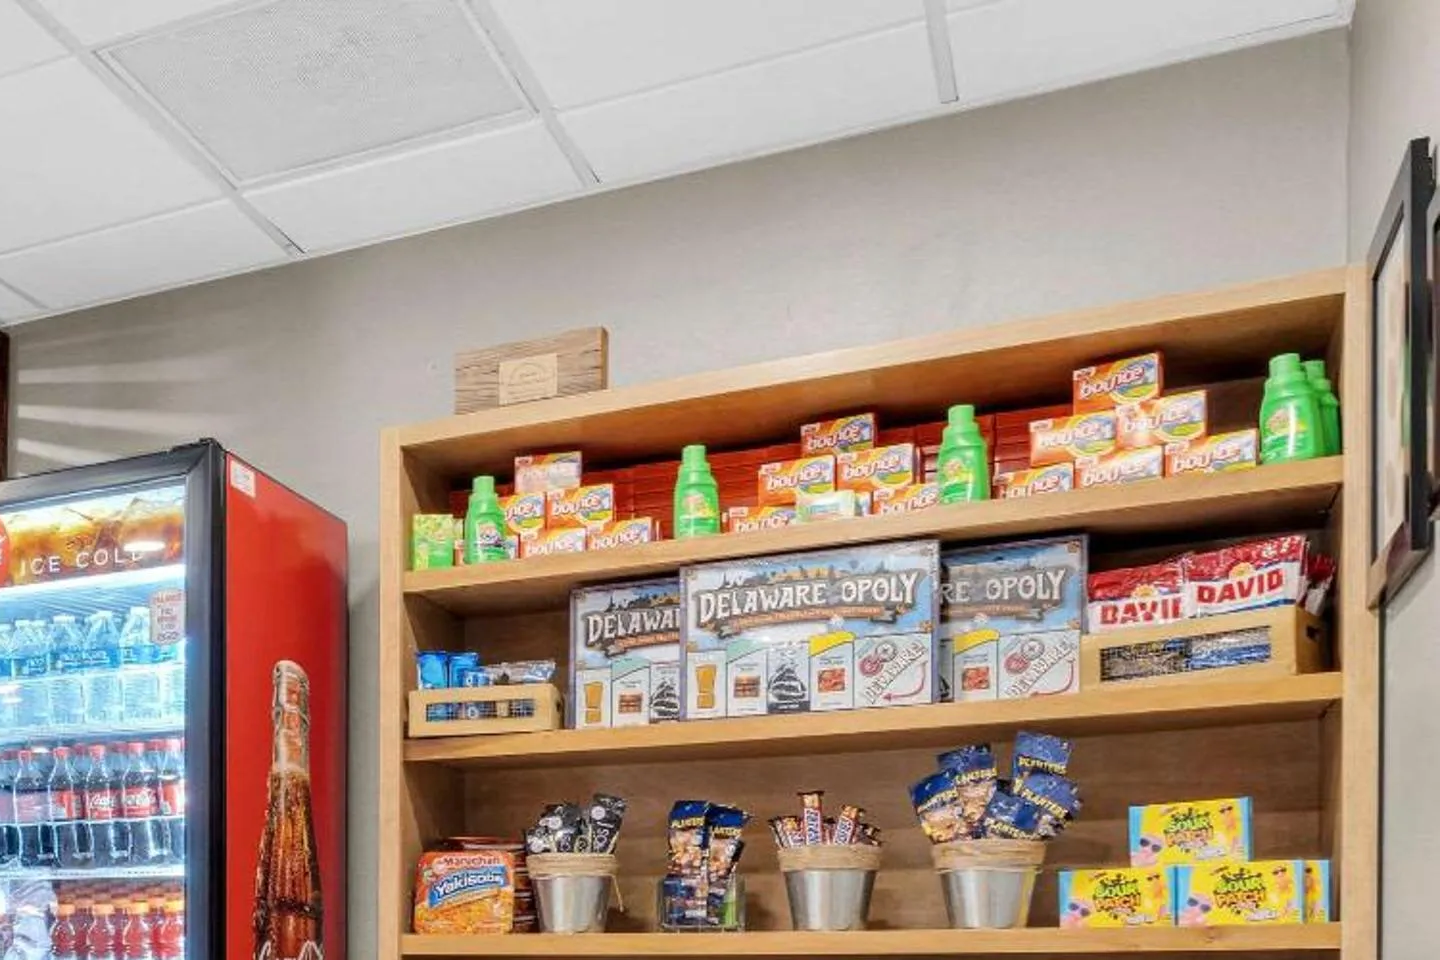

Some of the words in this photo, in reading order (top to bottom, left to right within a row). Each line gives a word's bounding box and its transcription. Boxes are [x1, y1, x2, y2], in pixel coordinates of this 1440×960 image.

[19, 555, 61, 577] ICE
[75, 545, 145, 569] COLD
[698, 583, 828, 624] DELAWARE
[841, 571, 919, 604] OPOLY
[986, 568, 1066, 602] OPOLY
[1197, 568, 1285, 605] DAVID
